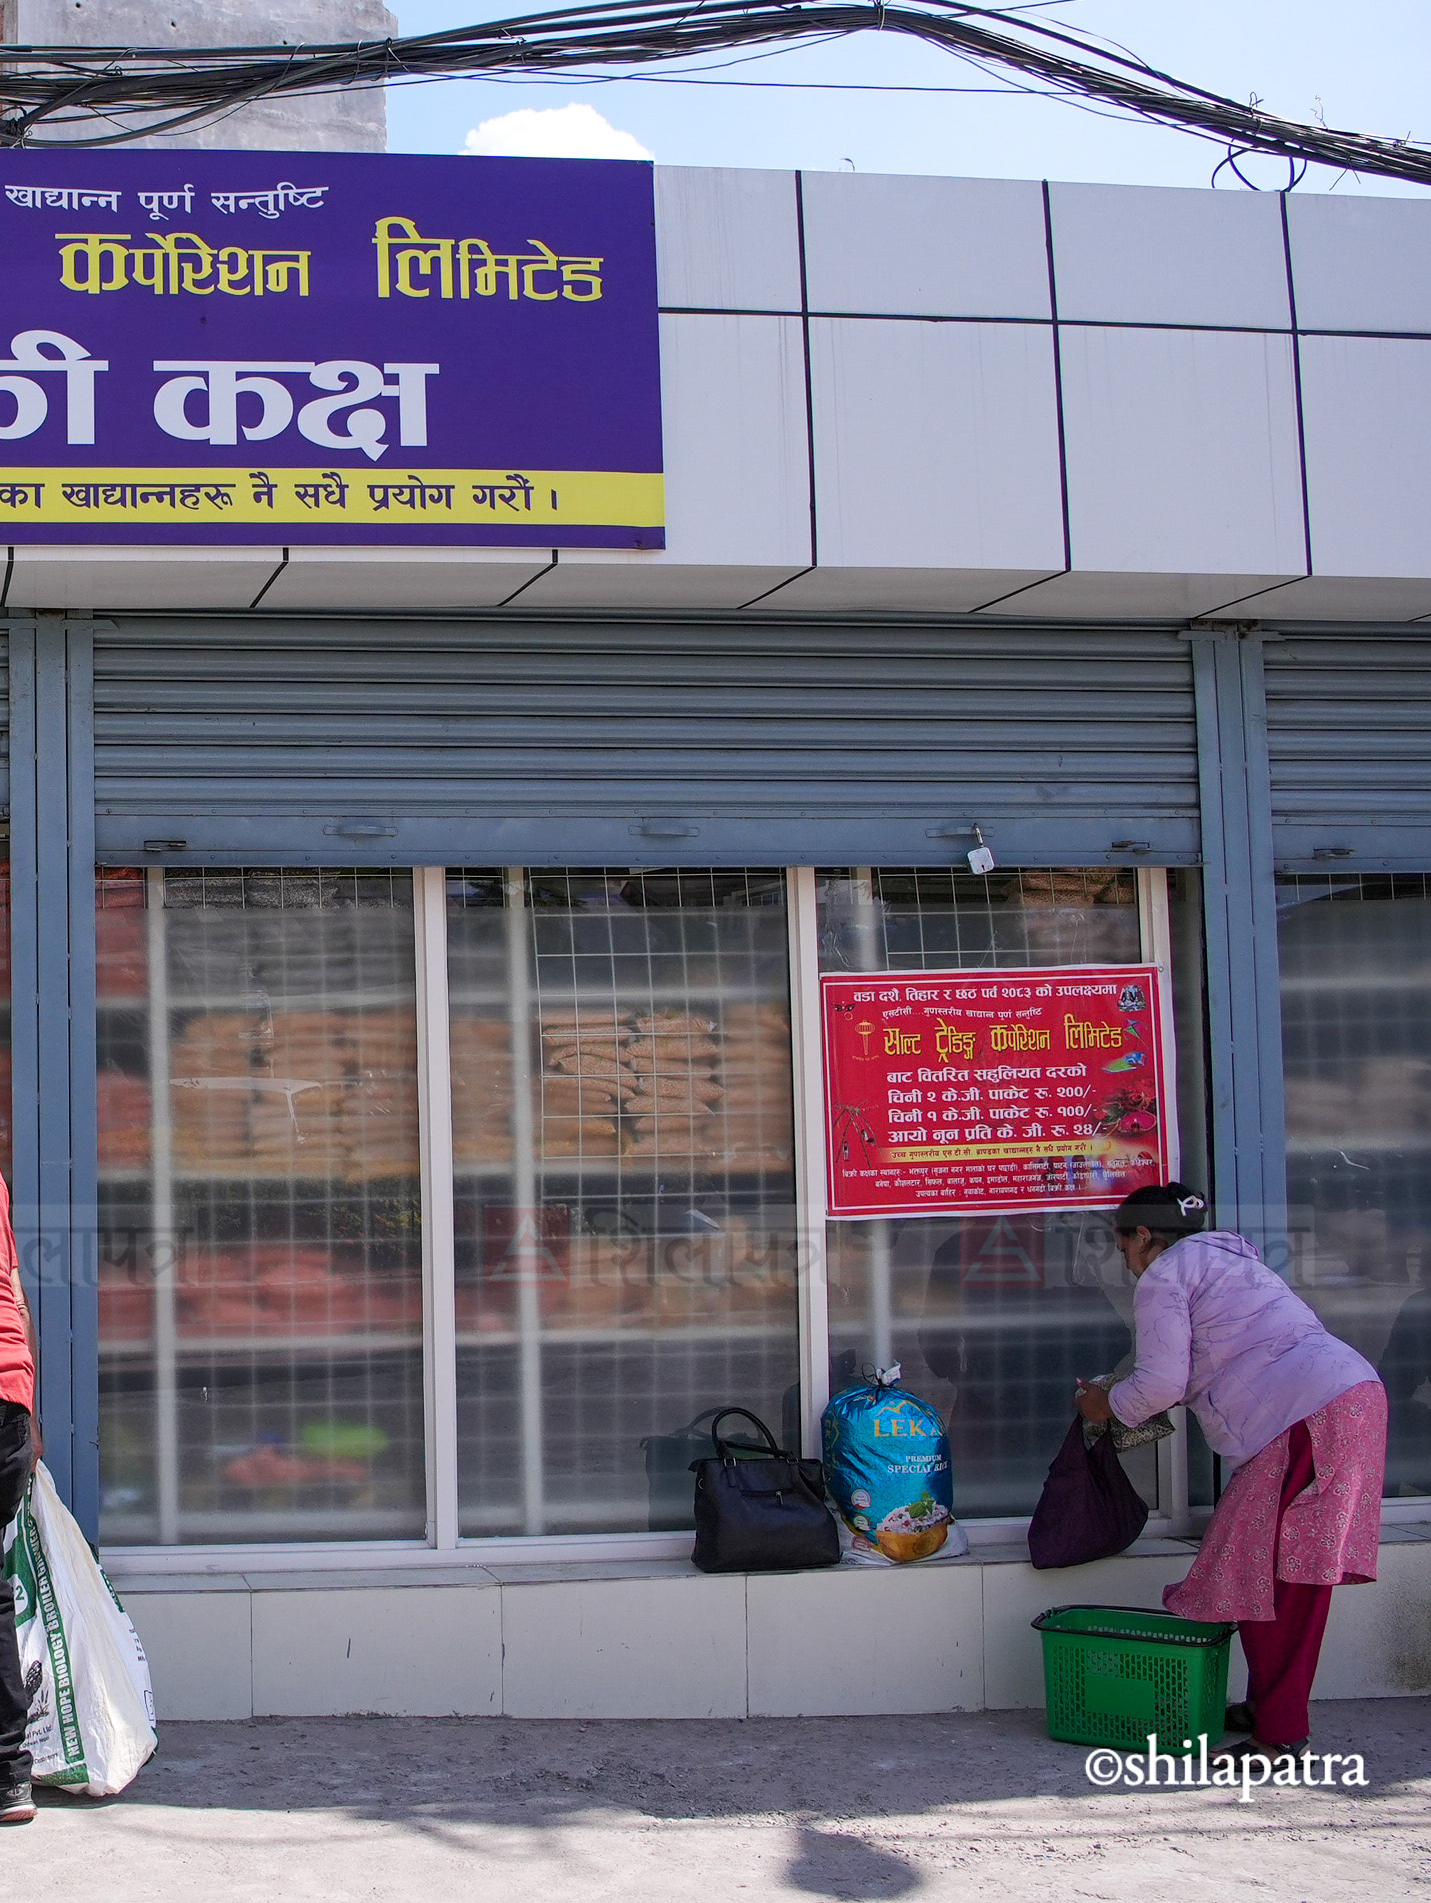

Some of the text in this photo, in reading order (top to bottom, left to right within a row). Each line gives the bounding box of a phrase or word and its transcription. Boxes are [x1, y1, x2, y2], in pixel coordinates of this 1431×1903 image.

[5, 185, 121, 213] खाद्यान्न
[138, 184, 195, 220] पूर्ण
[211, 181, 329, 219] सन्तुष्टि
[372, 216, 604, 302] लिमिटेड
[153, 359, 440, 462] कक्ष
[249, 472, 278, 510] नै
[294, 471, 349, 510] सधै
[367, 475, 455, 512] प्रयोग
[472, 473, 534, 512] गरौं
[905, 987, 940, 1001] तिहार
[943, 989, 952, 1000] र
[955, 988, 977, 1000] छठ
[981, 985, 998, 999] पर्व
[1002, 987, 1031, 998] २०८३
[1036, 984, 1052, 997] को
[1055, 984, 1117, 997] उपलक्ष्यमा
[883, 1028, 922, 1055] साल्ट
[1064, 1013, 1122, 1050] लिमिटेड
[887, 1062, 1087, 1083] बाट वितरित सहुलियत दरको
[888, 1089, 922, 1104] चिनी
[927, 1091, 936, 1102] २
[988, 1085, 1030, 1100] पाकेट
[888, 1108, 923, 1123] चिनी
[927, 1111, 937, 1122] १
[989, 1104, 1030, 1119] पाकेट
[888, 1126, 927, 1143] आयो
[932, 1128, 959, 1144] नून
[964, 1124, 992, 1141] प्रति
[38, 1575, 60, 1633] BROILER
[50, 1632, 71, 1689] BIOLOGY
[58, 1688, 75, 1727] HOPE
[63, 1726, 81, 1757] NEW
